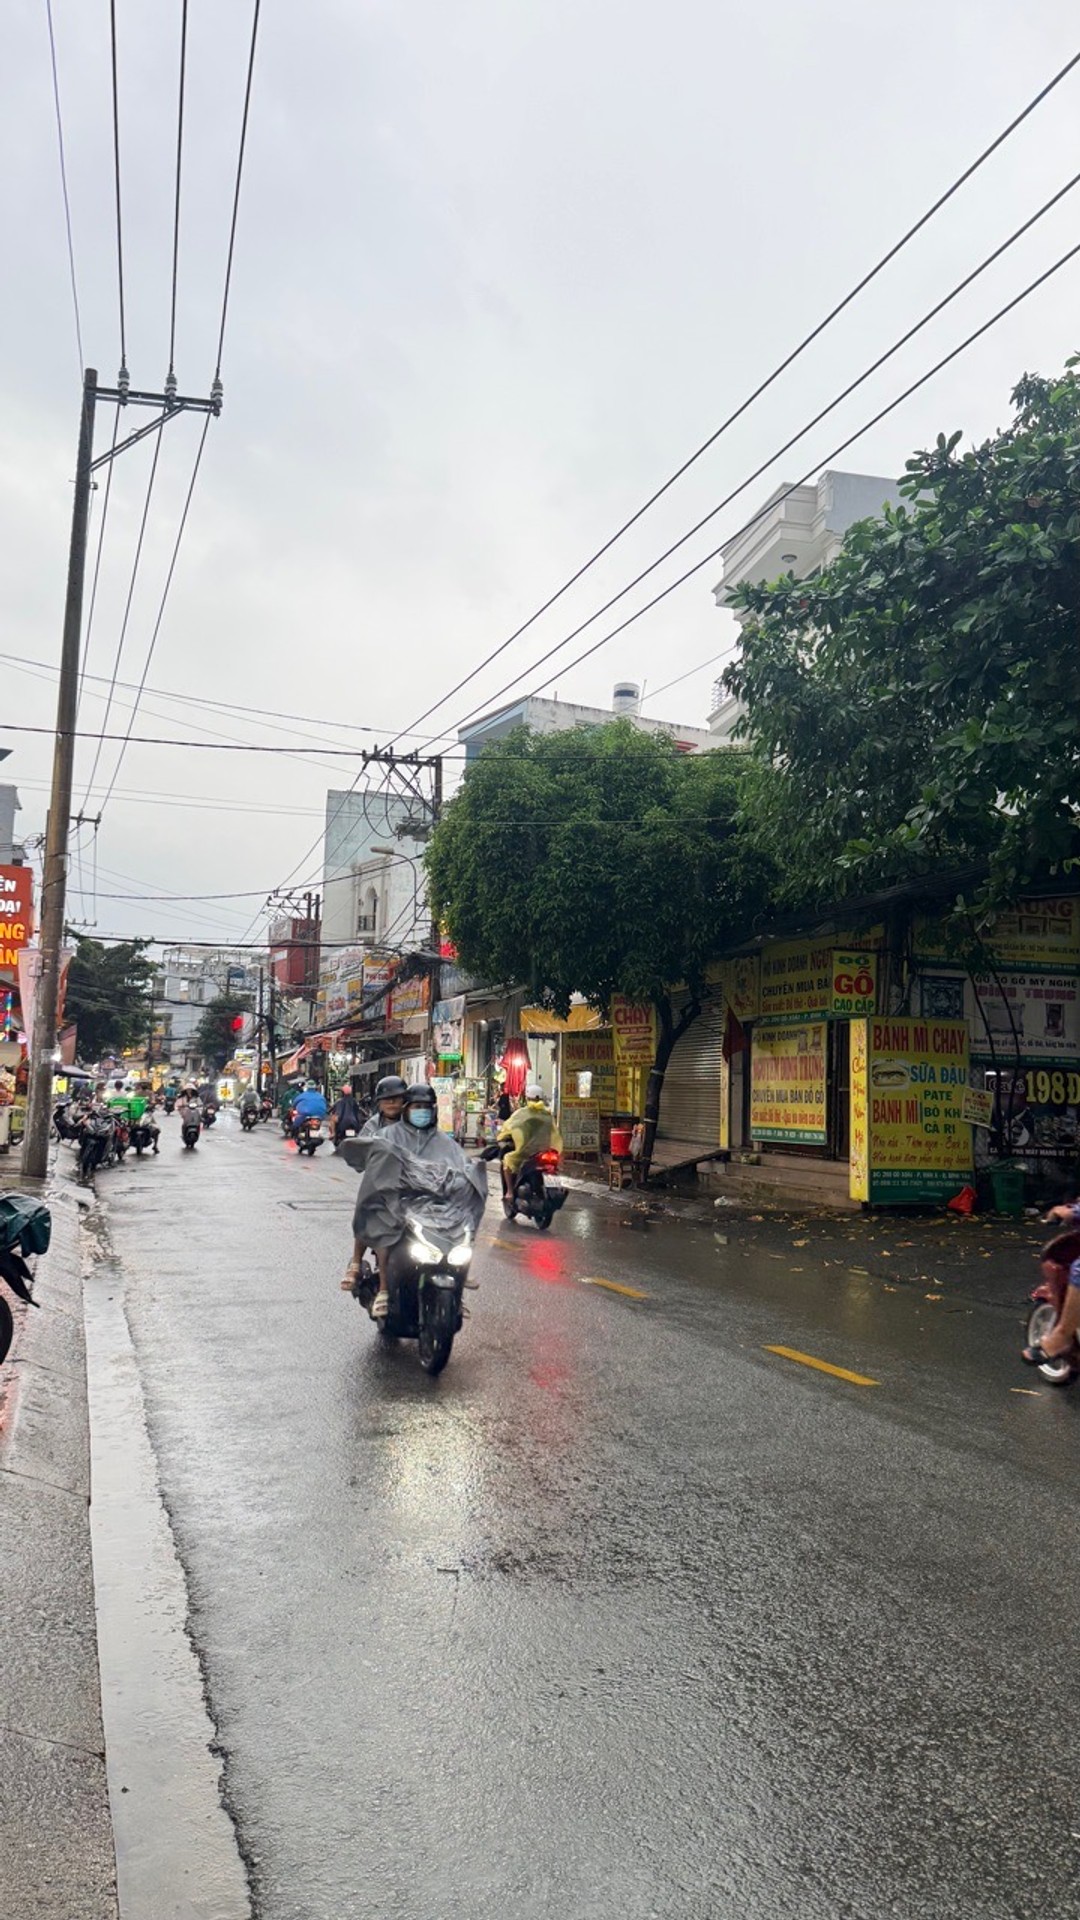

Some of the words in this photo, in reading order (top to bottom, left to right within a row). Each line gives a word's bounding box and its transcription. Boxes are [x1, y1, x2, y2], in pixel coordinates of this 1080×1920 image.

[796, 979, 814, 993] MUA
[834, 966, 874, 995] GỖ
[834, 998, 851, 1012] CAO
[855, 997, 874, 1012] CẤP
[615, 1007, 652, 1025] CHAY
[873, 1019, 909, 1052] BÁNH
[914, 1020, 929, 1052] MÌ
[933, 1027, 966, 1054] CHAY
[910, 1061, 936, 1083] SỮA
[940, 1062, 966, 1088] ĐẬU
[924, 1090, 953, 1101] PATE
[1025, 1070, 1080, 1105] 198D
[873, 1093, 901, 1124] BÁNH
[906, 1094, 919, 1124] MÌ
[924, 1104, 940, 1117] BÒ
[944, 1107, 961, 1118] KH
[944, 1124, 956, 1134] RI
